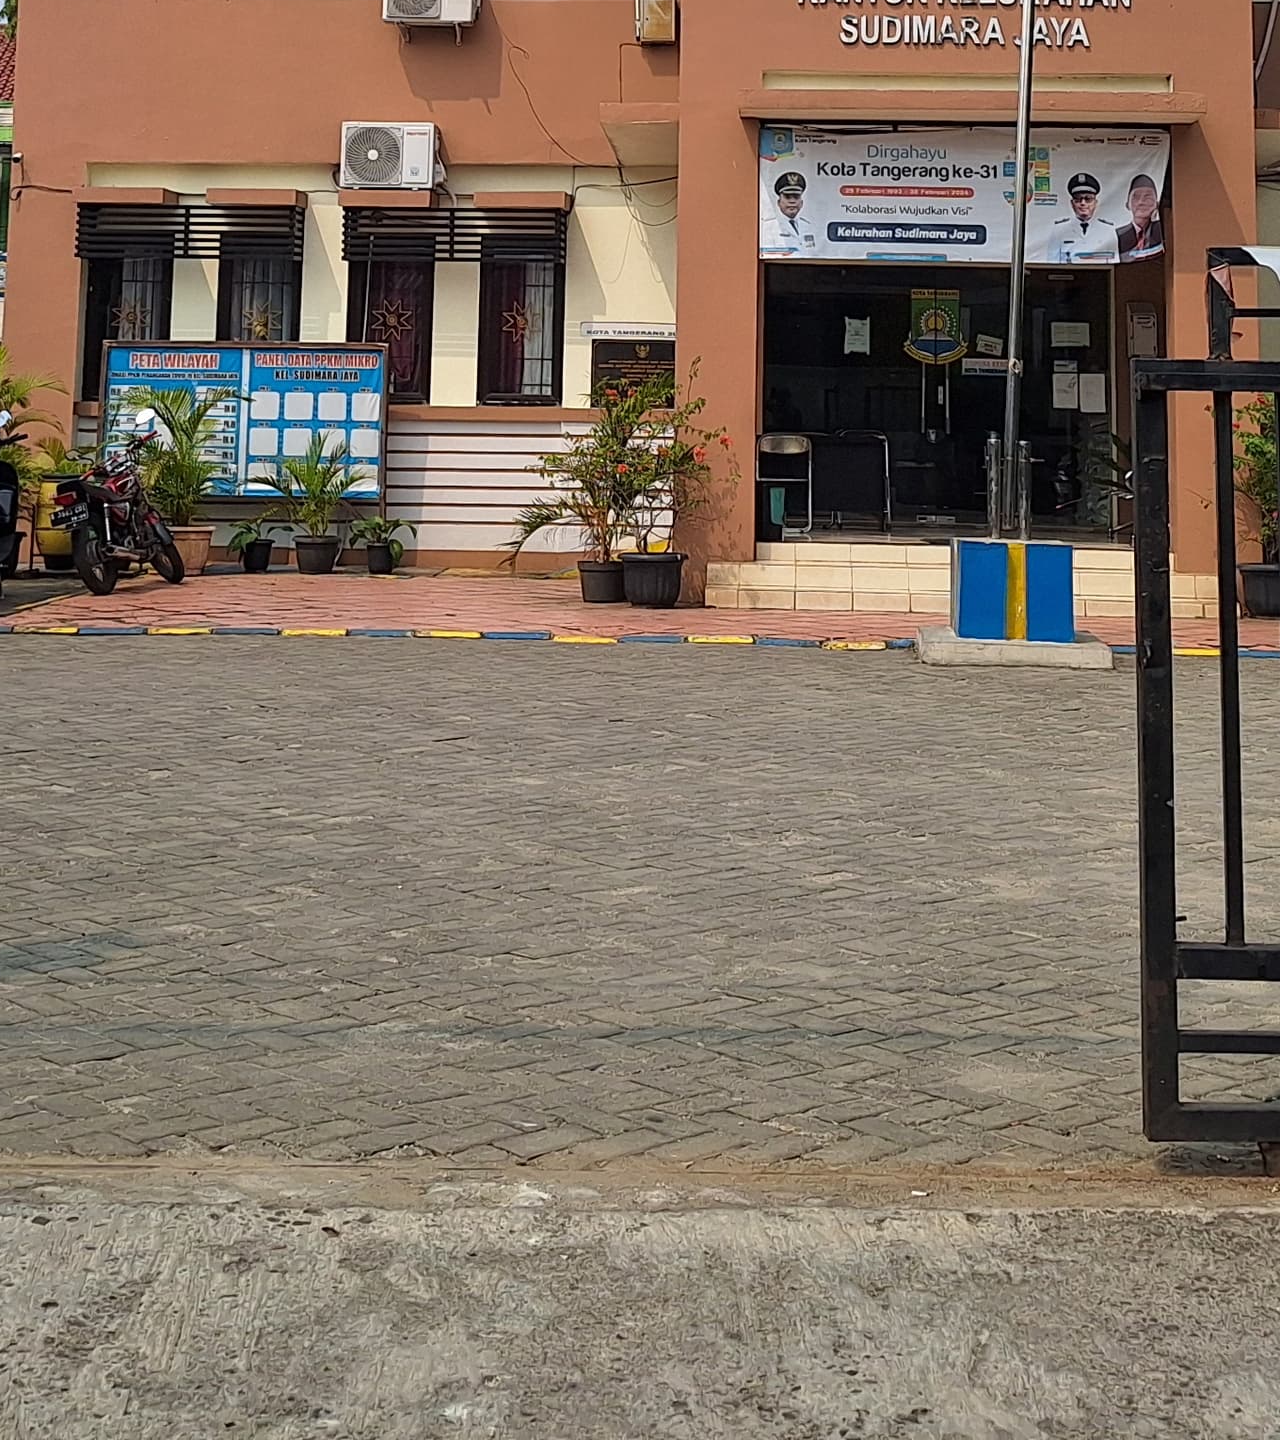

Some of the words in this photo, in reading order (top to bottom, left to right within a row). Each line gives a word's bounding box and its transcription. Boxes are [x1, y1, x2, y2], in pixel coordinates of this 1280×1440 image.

[838, 14, 1006, 47] SUDIMARA
[867, 144, 947, 162] Dirgahayu
[817, 162, 856, 177] Kota
[858, 162, 950, 182] Tangerang
[952, 163, 998, 179] ke-31
[899, 205, 949, 217] Wujudkan
[837, 226, 893, 239] Kelurahan
[894, 228, 948, 240] Sudimara
[948, 229, 978, 242] Jaya
[612, 329, 665, 337] TANGERANG
[130, 351, 163, 369] PETA
[164, 352, 220, 369] WILAYAH
[255, 352, 286, 368] PANEL
[287, 353, 313, 368] DATA
[314, 354, 343, 368] PPKM
[345, 355, 379, 369] MIKRO
[294, 370, 339, 381] SUDIMARA
[340, 370, 360, 382] JAYA
